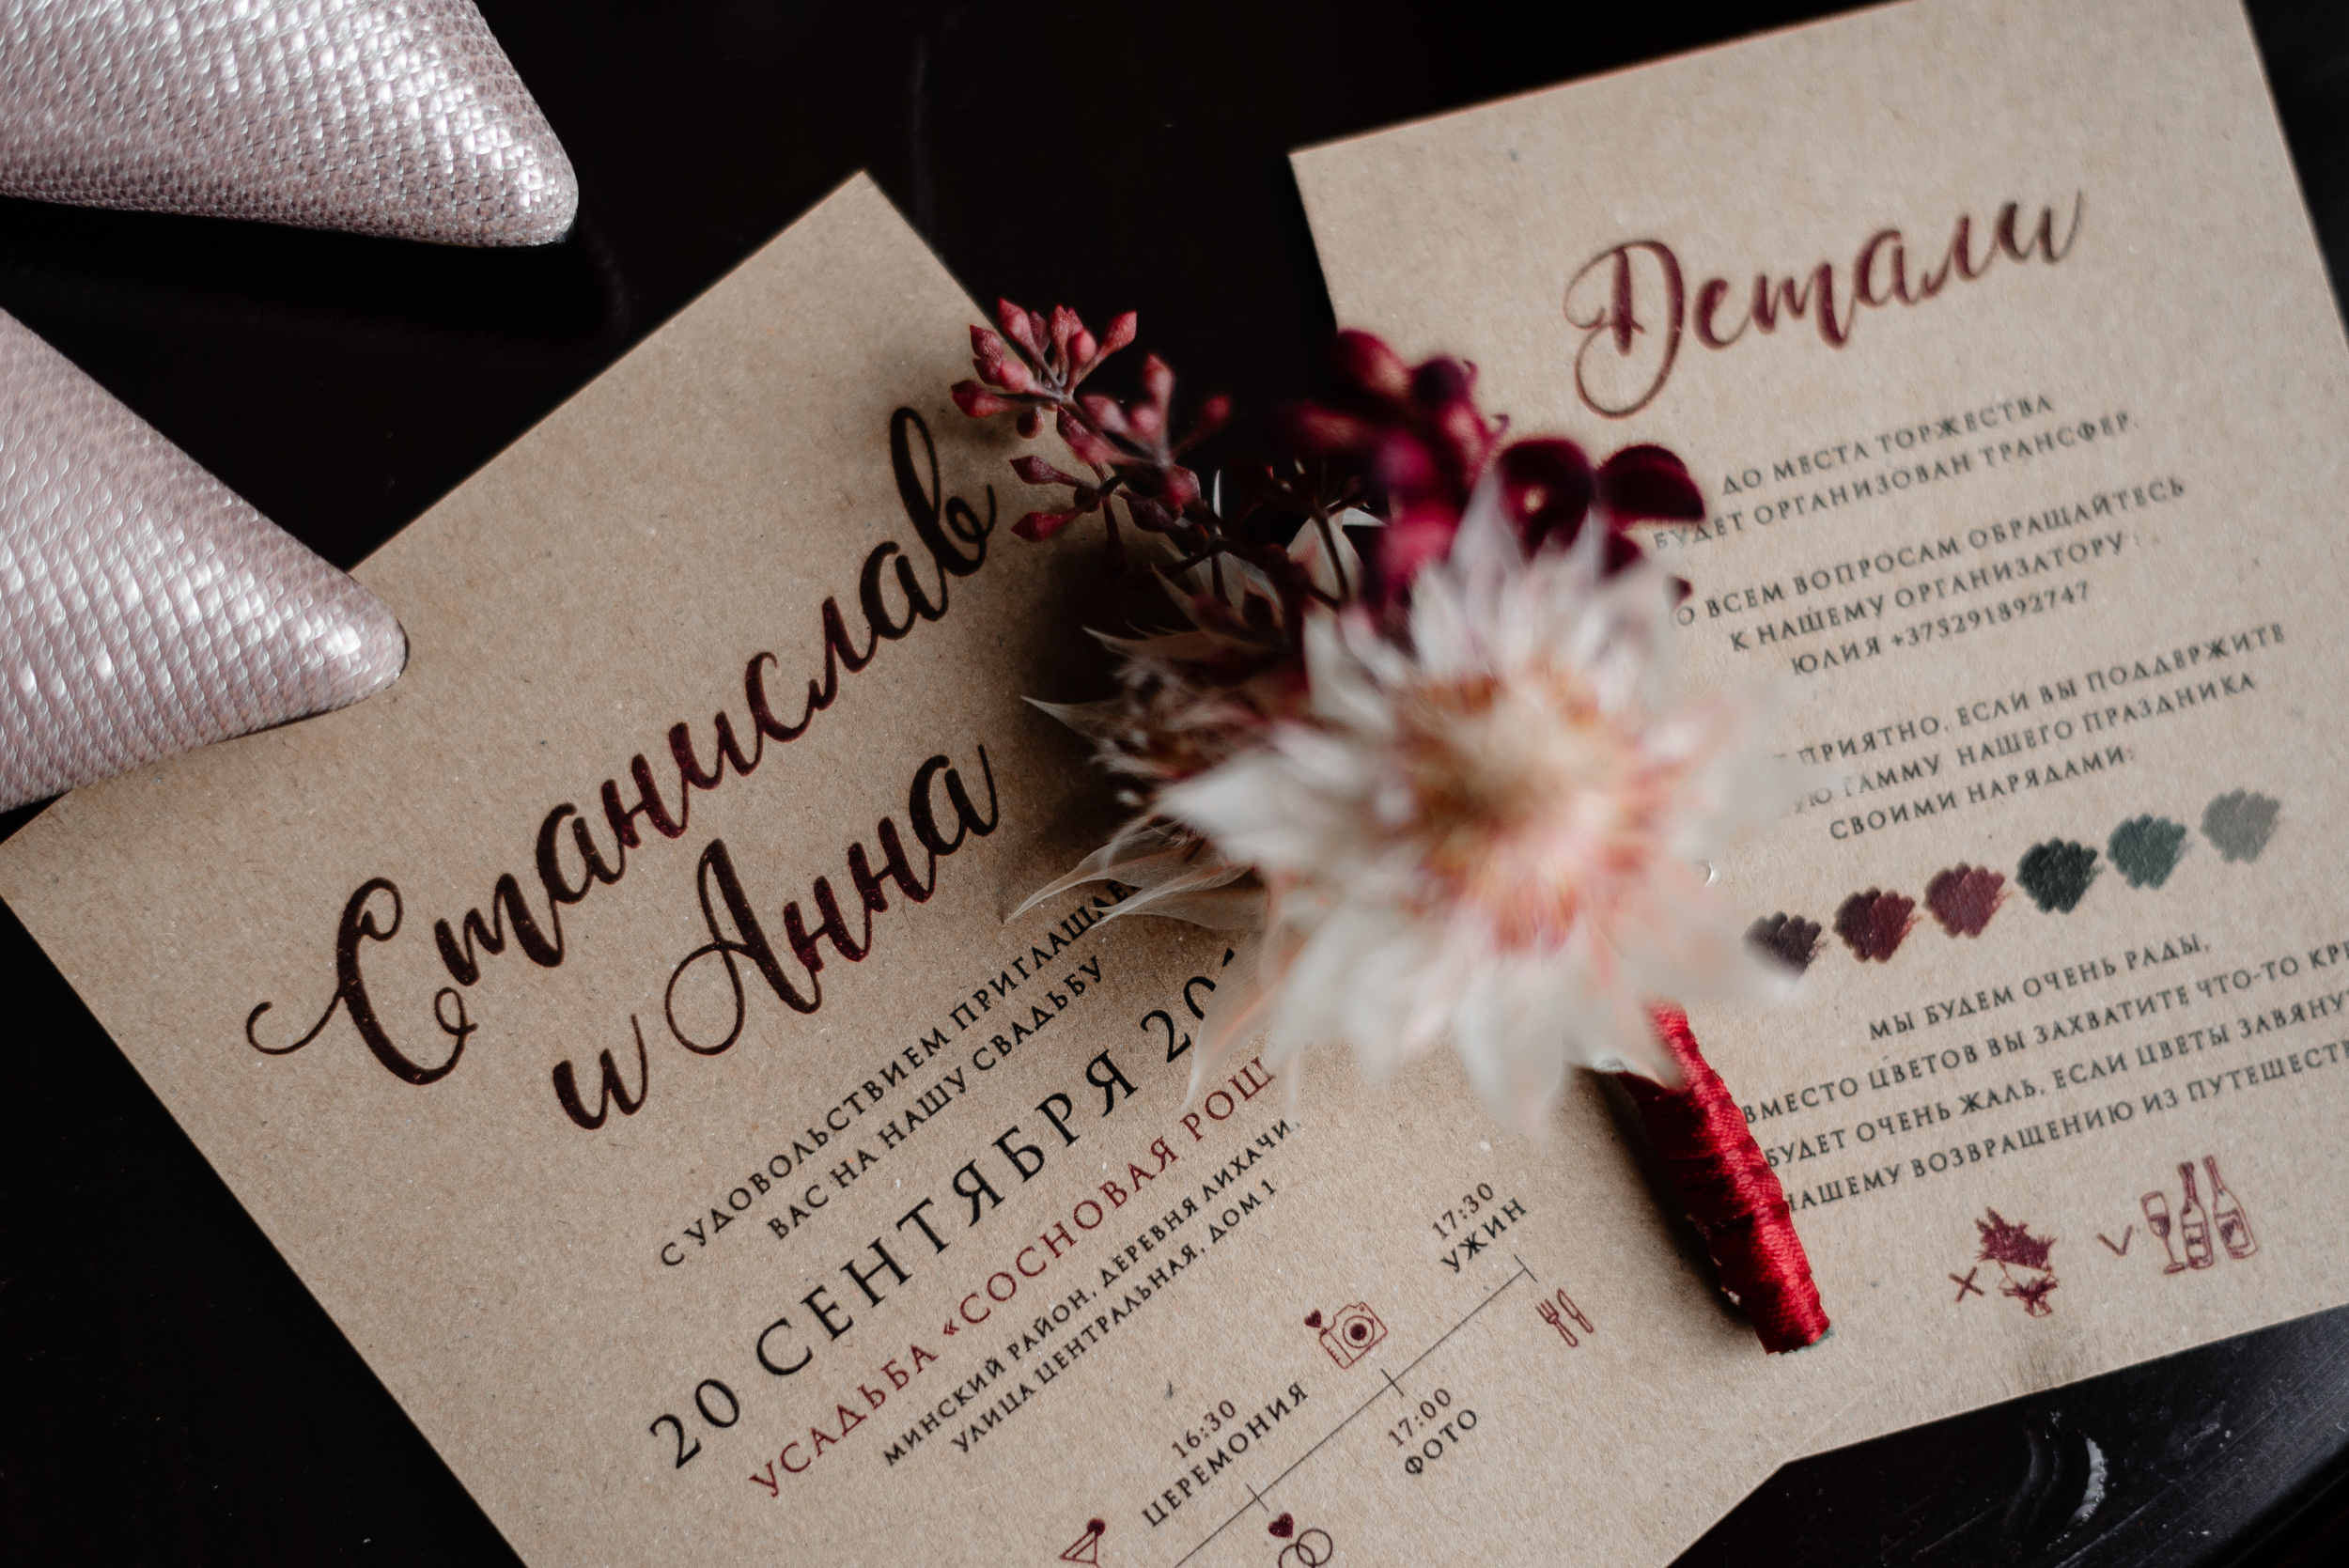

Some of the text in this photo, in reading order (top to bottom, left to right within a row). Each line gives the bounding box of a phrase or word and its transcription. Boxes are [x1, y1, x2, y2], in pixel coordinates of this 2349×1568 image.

[1562, 188, 2082, 420] Детали
[1654, 512, 1742, 550] БУДЕТ
[1754, 453, 1971, 525] ОРГАНИЗОВАН
[1724, 395, 2053, 494] ДО МЕСТА ТОРЖЕСТВА
[1705, 582, 1785, 618] ВСЕМ
[1793, 536, 1960, 595] ВОПРОСАМ
[1968, 477, 2185, 549] ОБРАЩАЙТЕСЬ
[1730, 631, 1750, 651] К
[1756, 595, 1884, 644] НАШЕМУ
[1791, 581, 2088, 675] ЮЛИЯ +375291892747
[1956, 691, 2030, 726] ЕСЛИ
[2039, 678, 2077, 704] ВЫ
[2085, 623, 2284, 692] ПОДДЕРЖИТЕ
[243, 407, 999, 1085] Станислав
[1842, 753, 1939, 797] ГАММУ
[1956, 721, 2073, 766] НАШЕГО
[2082, 674, 2255, 733] ПРАЗДНИКА
[1829, 791, 1957, 840] СВОИМИ
[552, 744, 1000, 1130] и Анна
[1743, 1078, 1859, 1124] ВМЕСТО
[1868, 1045, 1979, 1090] ЦВЕТОВ
[1986, 1031, 2026, 1058] ВЫ
[2034, 986, 2189, 1045] ЗАХВАТИТЕ
[2196, 955, 2299, 998] ЧТО-ТО
[1869, 1012, 1915, 1041] МЫ
[1923, 986, 2015, 1026] БУДЕМ
[2023, 957, 2117, 998] ОЧЕНЬ
[660, 880, 1141, 1266] С УДОВОЛЬСТВИЕМ ПРИГЛАШАЕ
[767, 955, 1101, 1240] ВАС НА НАШУ СВАДЬБУ
[1764, 1129, 1845, 1168] БУДЕТ
[1856, 1102, 1952, 1142] ОЧЕНЬ
[2052, 1053, 2128, 1089] ЕСЛИ
[2136, 1024, 2230, 1066] ЦВЕТЫ
[1910, 1101, 2135, 1178] ВОЗВРАЩЕНИЮ
[2141, 1088, 2179, 1114] ИЗ
[648, 1378, 740, 1469] 20
[755, 1053, 1139, 1378] СЕНТЯБРЯ
[1432, 1183, 1494, 1240] 17:30
[1439, 1198, 1527, 1274] УЖИН
[748, 1343, 939, 1497] УСАДЬБА
[942, 1135, 1179, 1336] «СОСНОВАЯ
[882, 1356, 1006, 1467] МИНСКИЙ
[1006, 1289, 1097, 1361] РАЙОН,
[1099, 1197, 1199, 1289] ДЕРЕВНЯ
[950, 1179, 1277, 1454] УЛИЦА ЦЕНТРАЛЬНАЯ, ДОМ 1
[1141, 1381, 1308, 1528] ЦЕРЕМОНИЯ
[1172, 1400, 1237, 1459] 16:30
[1388, 1388, 1452, 1447] 17:00
[1405, 1409, 1477, 1476] ФОТО
